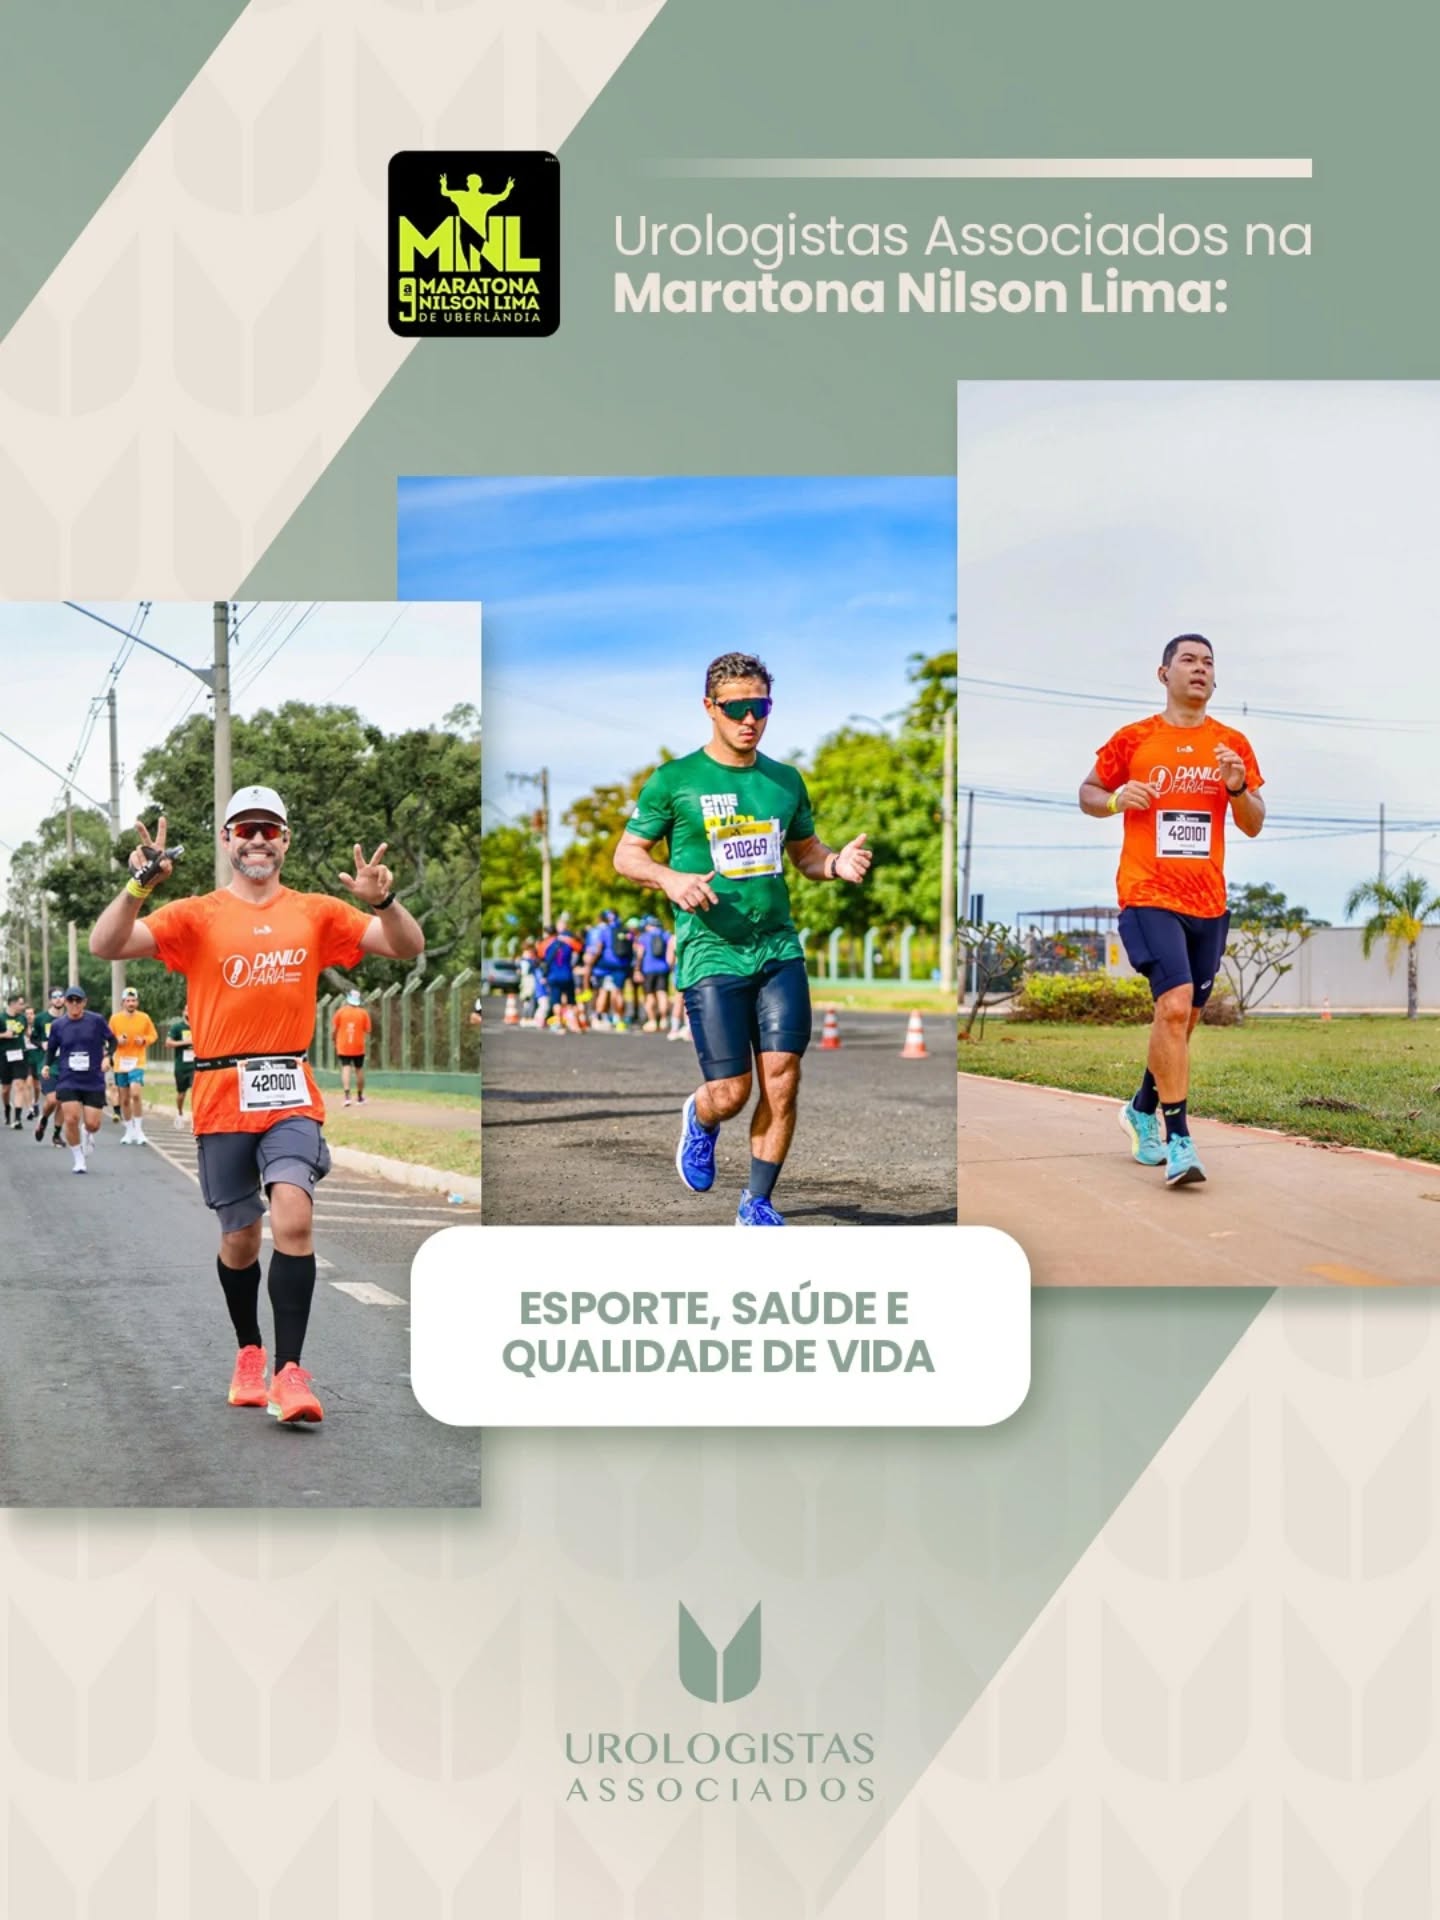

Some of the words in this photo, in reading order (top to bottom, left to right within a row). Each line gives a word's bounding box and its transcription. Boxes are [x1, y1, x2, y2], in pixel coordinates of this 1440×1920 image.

[1176, 766, 1221, 781] DANILO
[1172, 780, 1203, 794] FARIA
[700, 793, 738, 808] CRIE
[1168, 826, 1205, 841] 420101
[724, 838, 767, 859] 210269
[254, 948, 306, 969] DANILO
[249, 967, 285, 986] FARIA
[251, 1074, 296, 1091] 420001
